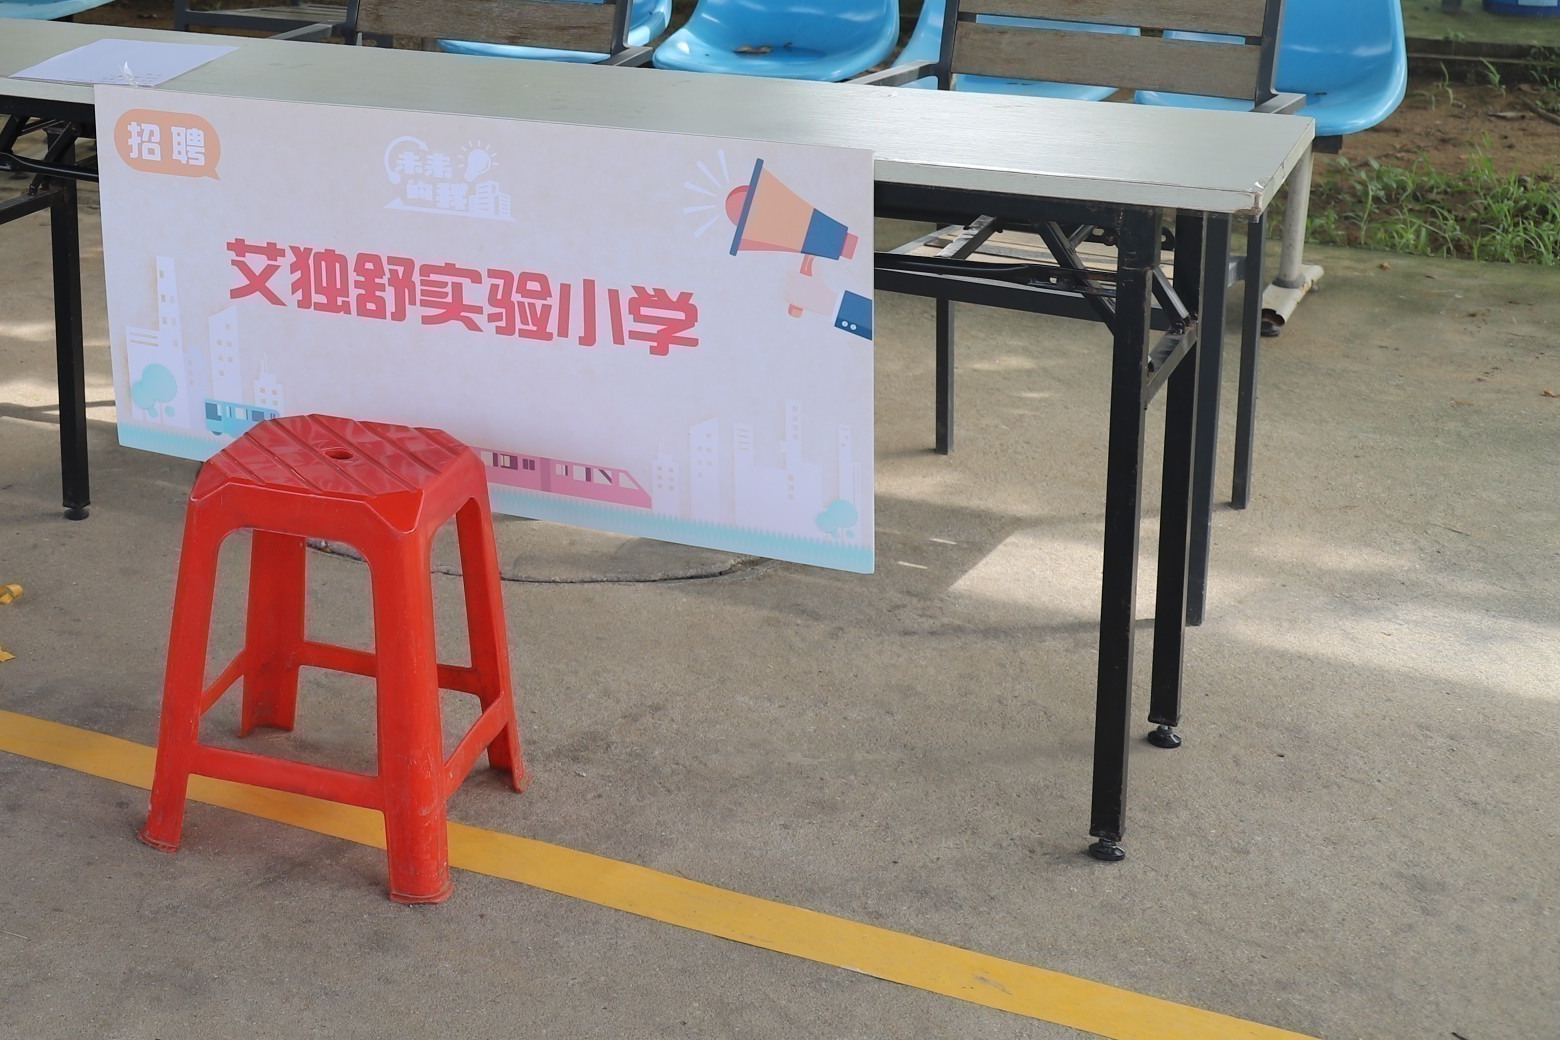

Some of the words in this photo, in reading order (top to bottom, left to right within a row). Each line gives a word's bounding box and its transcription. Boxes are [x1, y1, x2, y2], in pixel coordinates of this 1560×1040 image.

[127, 120, 205, 168] 招聘
[226, 237, 700, 357] 艾独舒实验小学
